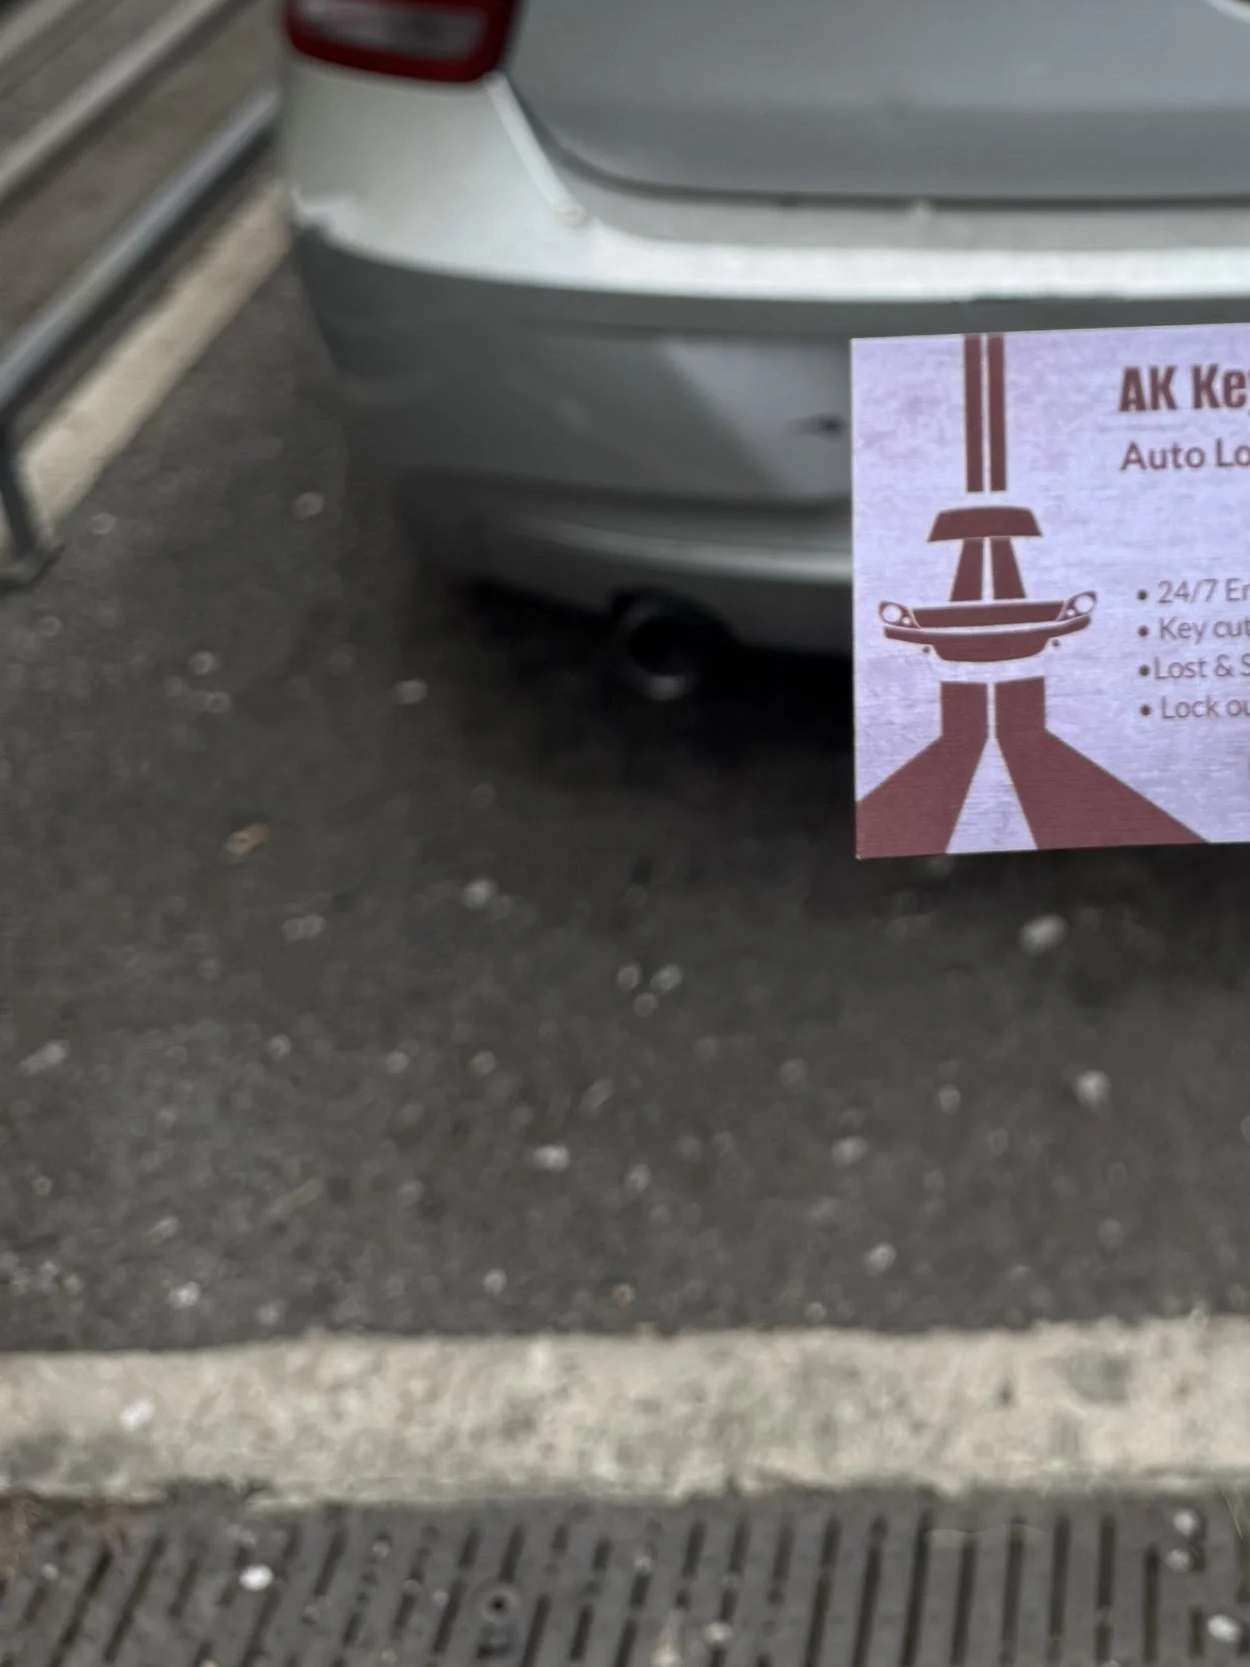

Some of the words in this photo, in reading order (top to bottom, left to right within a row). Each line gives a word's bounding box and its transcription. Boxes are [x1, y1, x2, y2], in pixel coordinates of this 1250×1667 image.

[1119, 365, 1177, 412] AK
[1120, 440, 1206, 471] Auto
[1157, 578, 1219, 605] 24/7
[1158, 615, 1208, 644] Key
[1153, 655, 1207, 681] Lost
[1213, 653, 1235, 678] &
[1161, 694, 1220, 720] Lock
